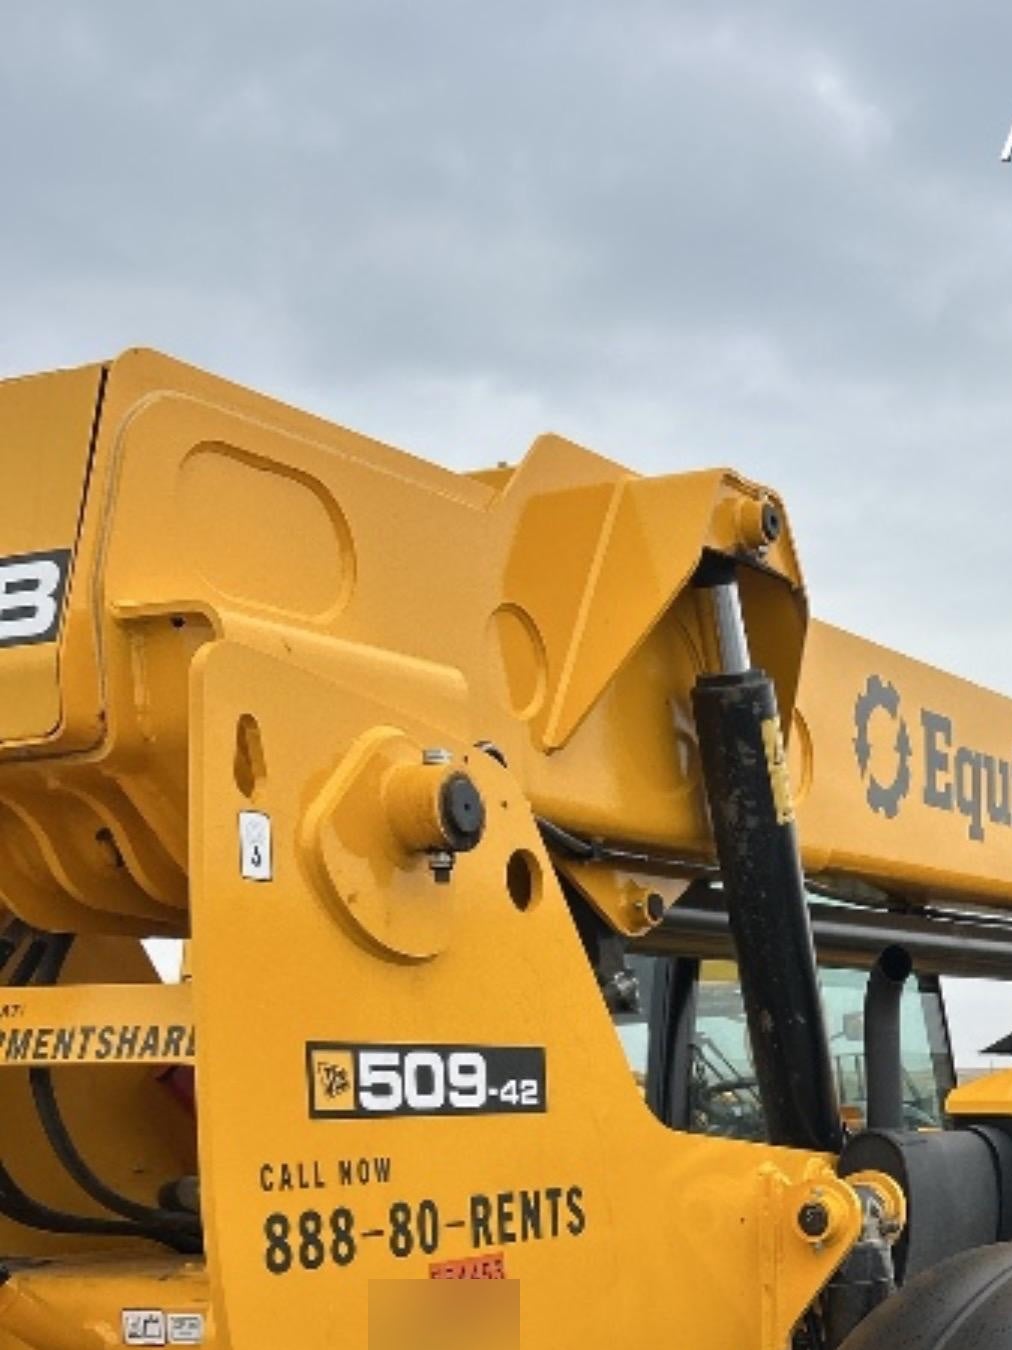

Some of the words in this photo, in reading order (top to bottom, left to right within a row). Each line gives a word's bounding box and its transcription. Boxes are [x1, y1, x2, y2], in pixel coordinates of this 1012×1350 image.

[0, 1024, 196, 1061] MENTSHAR
[358, 1051, 539, 1111] 509-42
[259, 1161, 326, 1192] CALL
[338, 1157, 392, 1186] NOW
[263, 1185, 586, 1275] 888-80-RENTS
